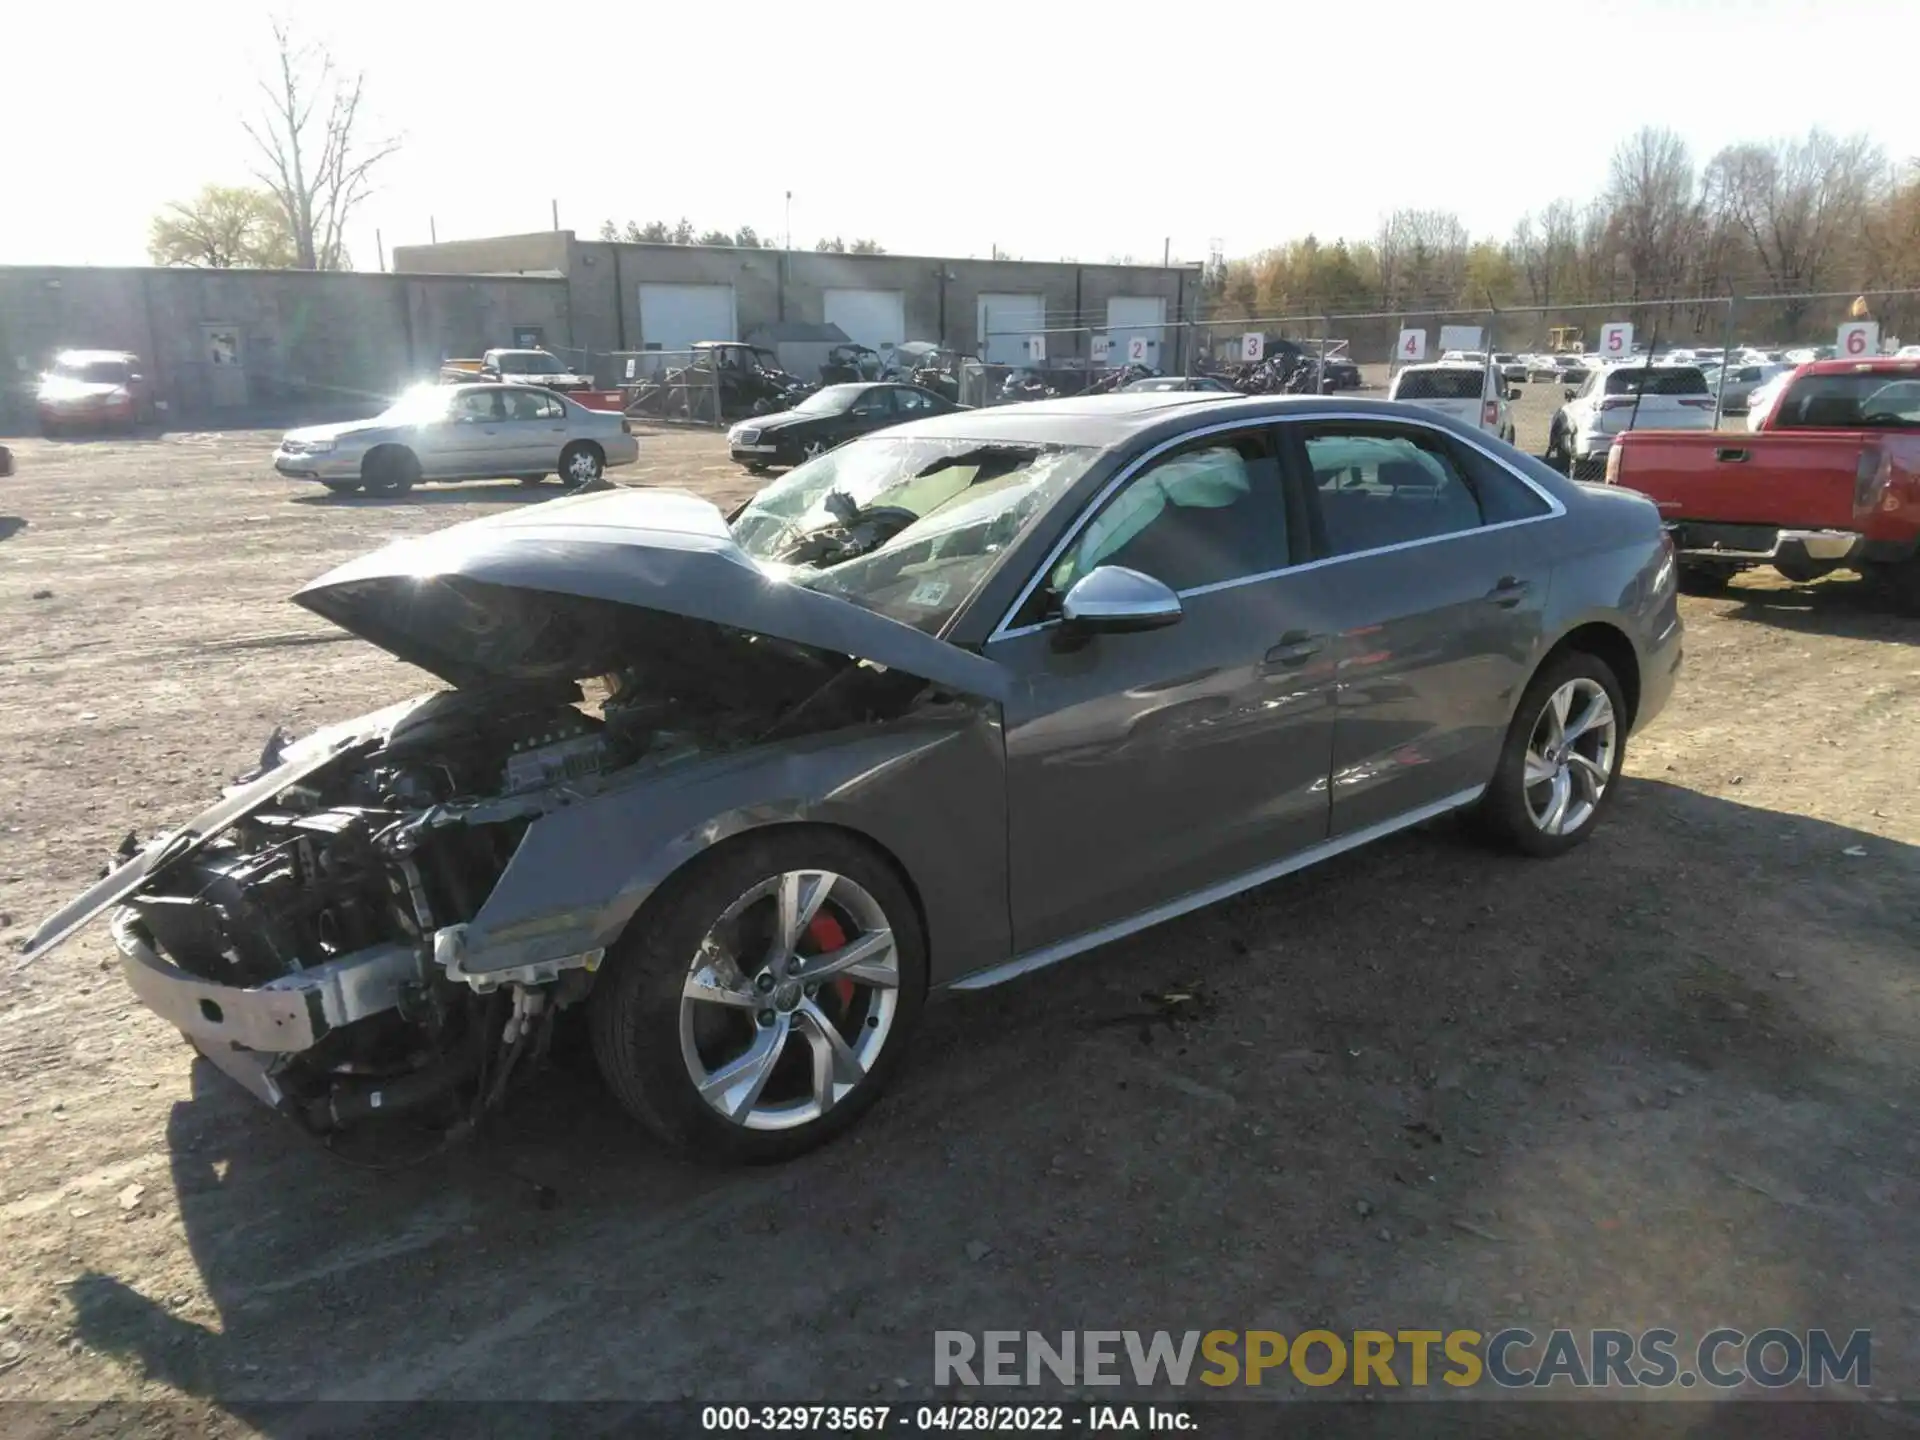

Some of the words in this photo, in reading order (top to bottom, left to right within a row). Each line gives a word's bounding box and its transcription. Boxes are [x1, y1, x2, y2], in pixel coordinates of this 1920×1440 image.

[1248, 338, 1258, 356] 3
[1405, 335, 1416, 354] 4
[1609, 329, 1622, 351] 5
[1848, 329, 1867, 354] 6
[1034, 341, 1041, 358] 1
[1133, 341, 1143, 358] 2
